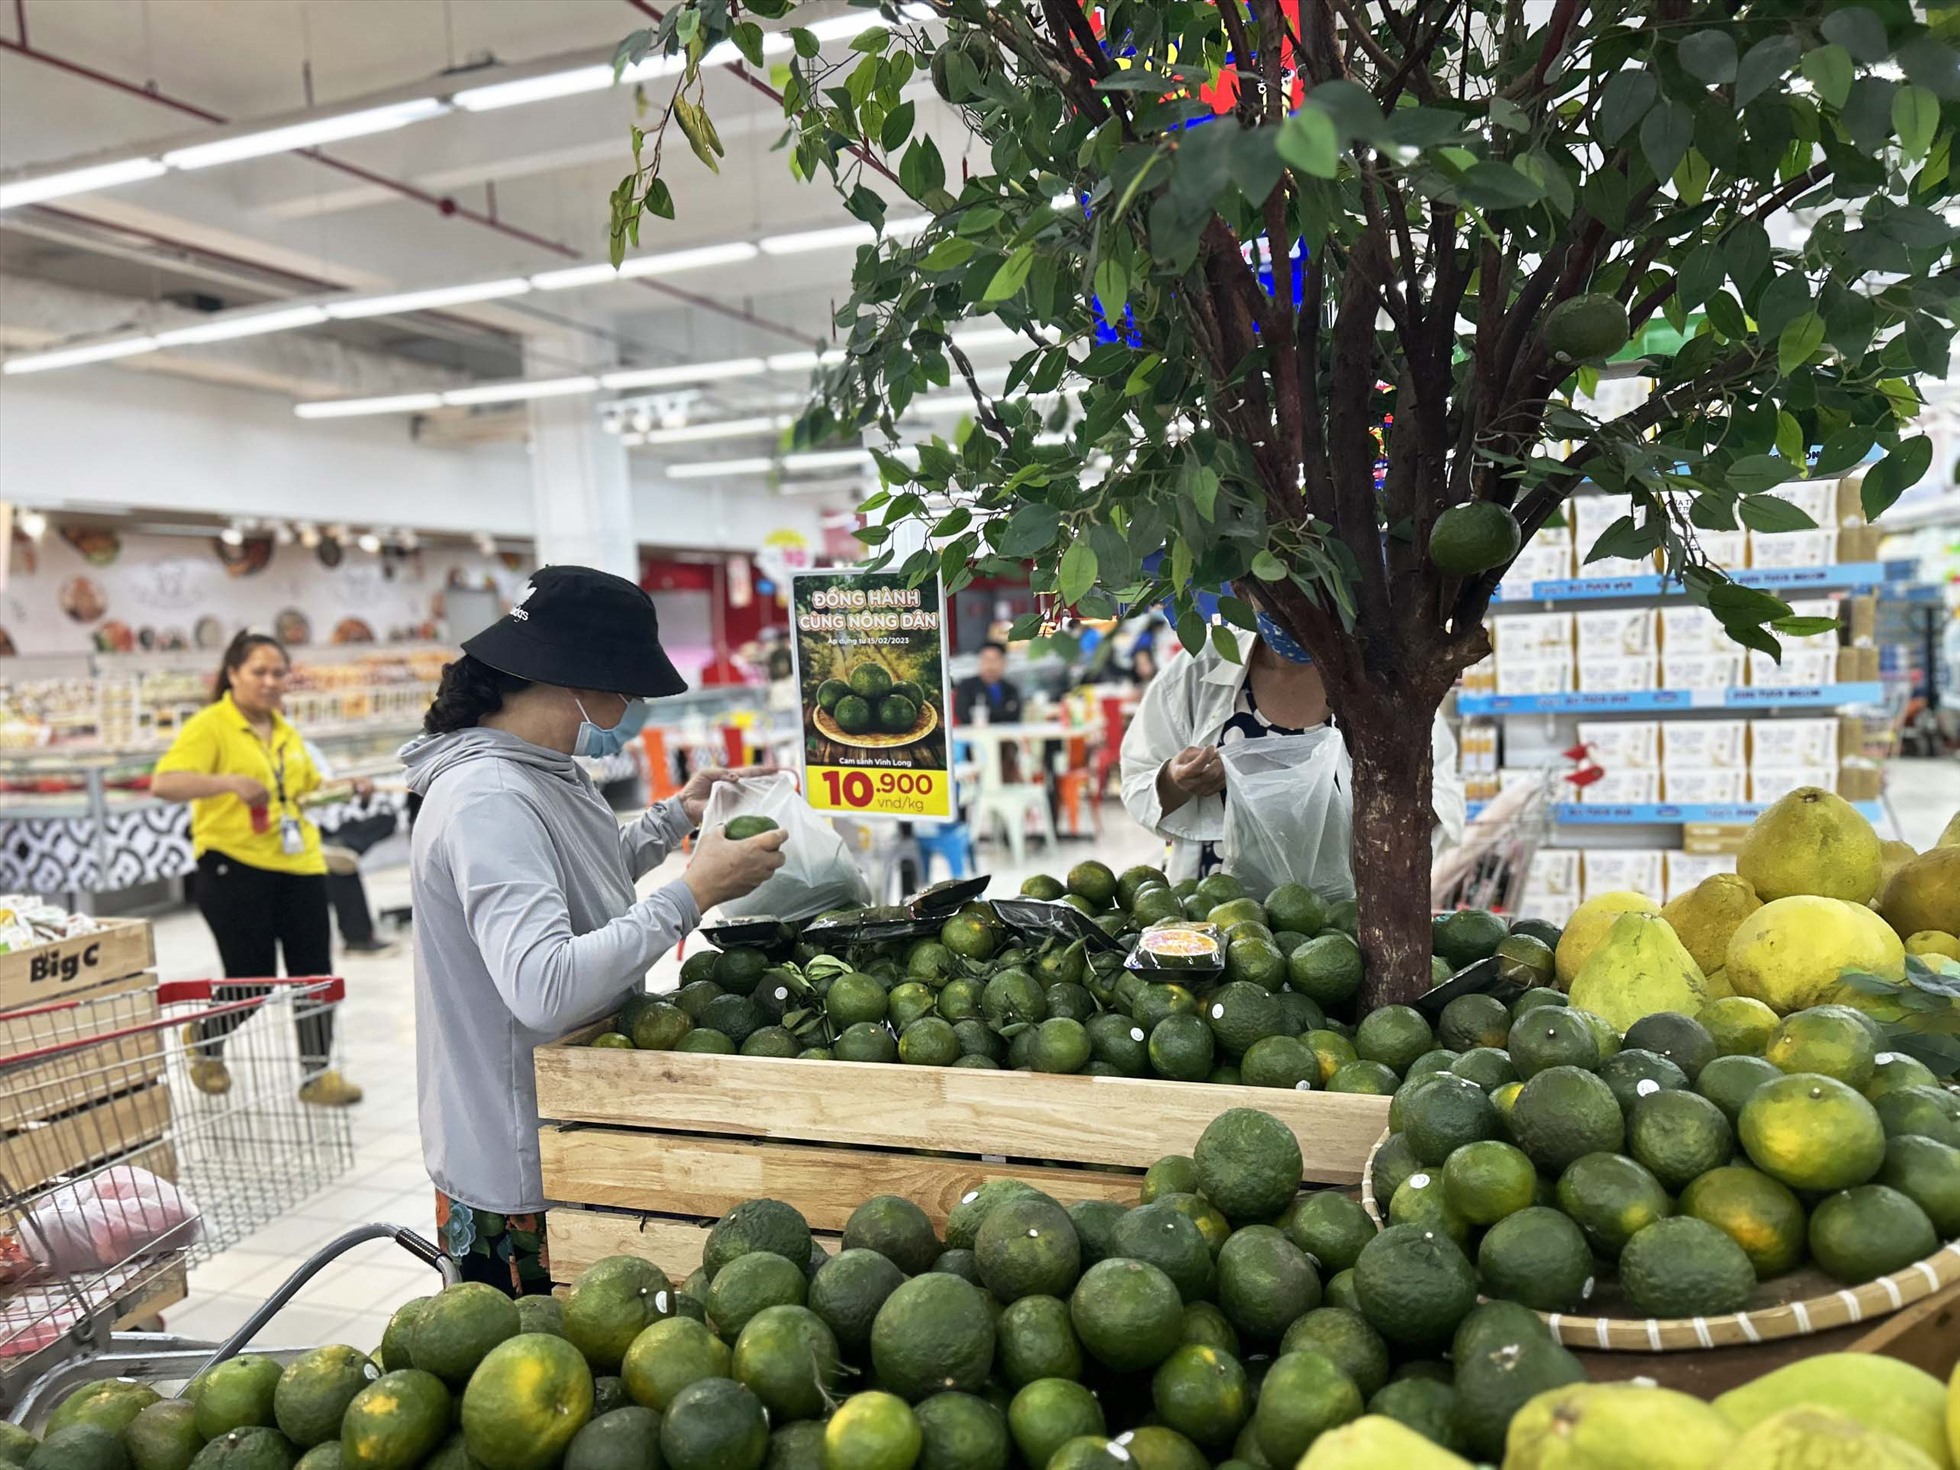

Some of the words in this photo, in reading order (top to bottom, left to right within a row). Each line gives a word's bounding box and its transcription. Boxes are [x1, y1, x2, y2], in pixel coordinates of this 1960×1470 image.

[868, 586, 920, 607] HÀNH
[799, 611, 844, 630] CÙNG
[848, 610, 898, 630] NÔNG
[901, 610, 937, 630] DÂN
[893, 759, 912, 768] Long
[30, 949, 80, 983] Big
[83, 942, 100, 967] C
